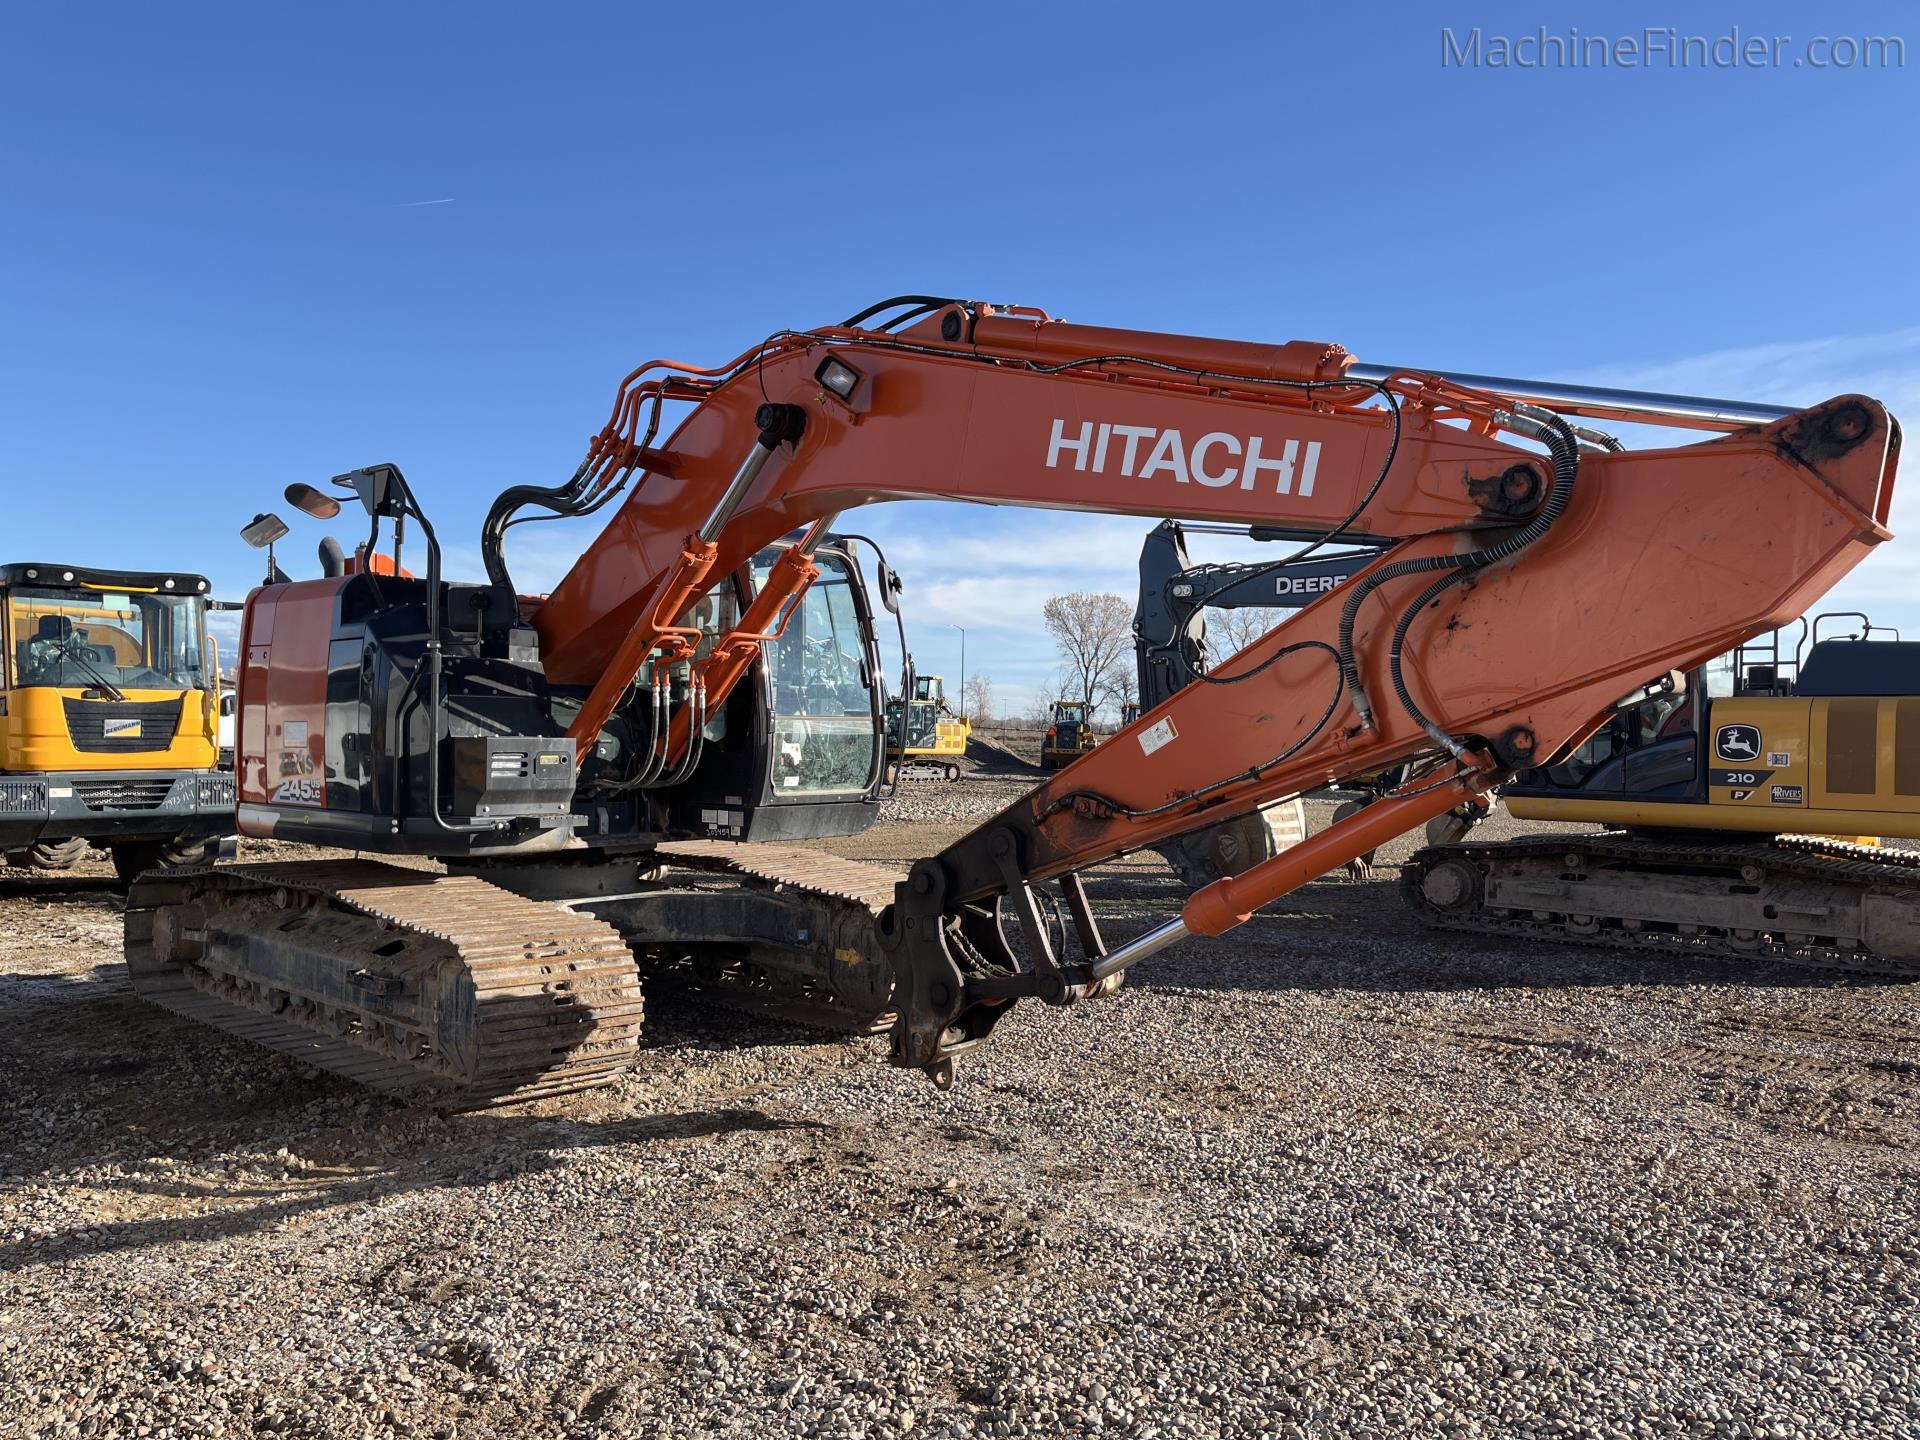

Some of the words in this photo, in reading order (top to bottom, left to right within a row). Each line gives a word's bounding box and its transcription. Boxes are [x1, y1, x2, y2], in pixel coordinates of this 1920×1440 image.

[1046, 419, 1322, 497] HITACHI
[105, 721, 141, 734] BERGMANN
[1727, 773, 1755, 783] 210
[279, 779, 312, 800] 245
[311, 789, 321, 799] LC
